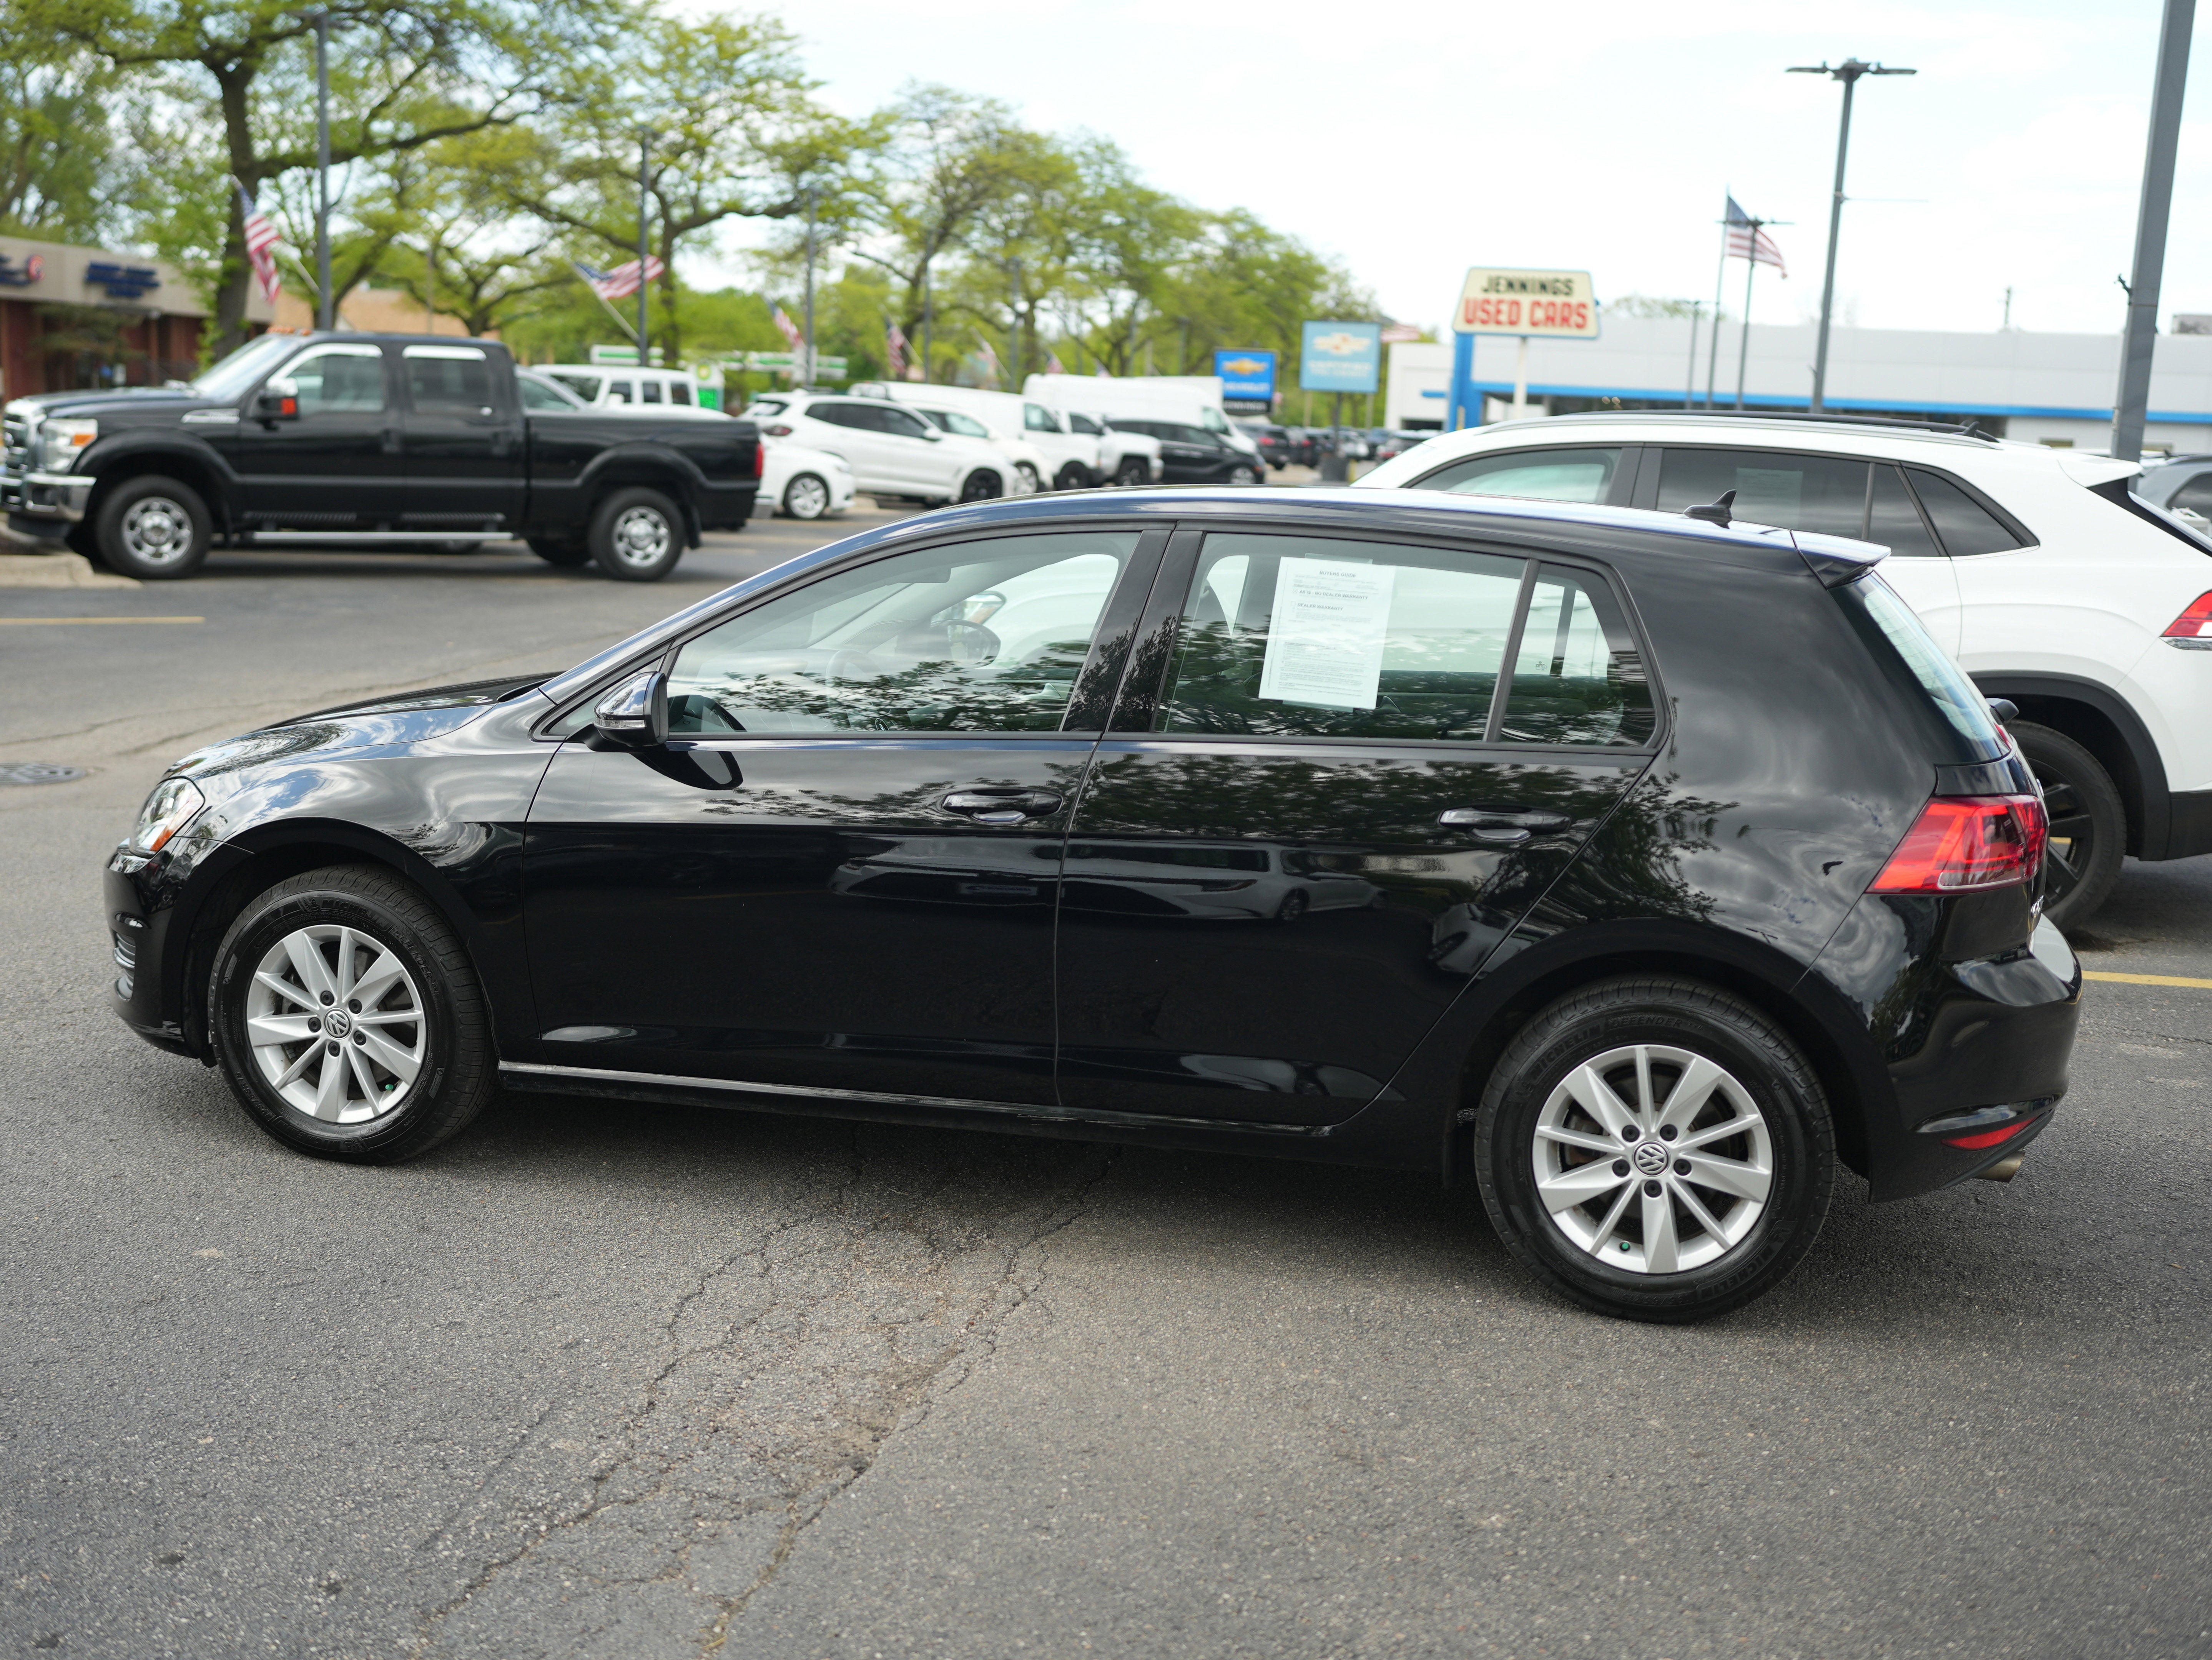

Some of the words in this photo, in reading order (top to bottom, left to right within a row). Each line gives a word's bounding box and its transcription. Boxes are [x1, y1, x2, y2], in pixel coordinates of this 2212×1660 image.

[1482, 276, 1574, 295] JENNINGS
[1464, 298, 1521, 326] USED
[1530, 300, 1587, 329] CARS
[322, 899, 389, 929] MICHELIN
[391, 927, 432, 978] DEFENDER
[1614, 1016, 1682, 1028] DEFENDER
[1530, 1024, 1600, 1080] MICHELIN
[276, 1120, 342, 1150] MICHELIN
[1701, 1247, 1773, 1300] MICHELIN
